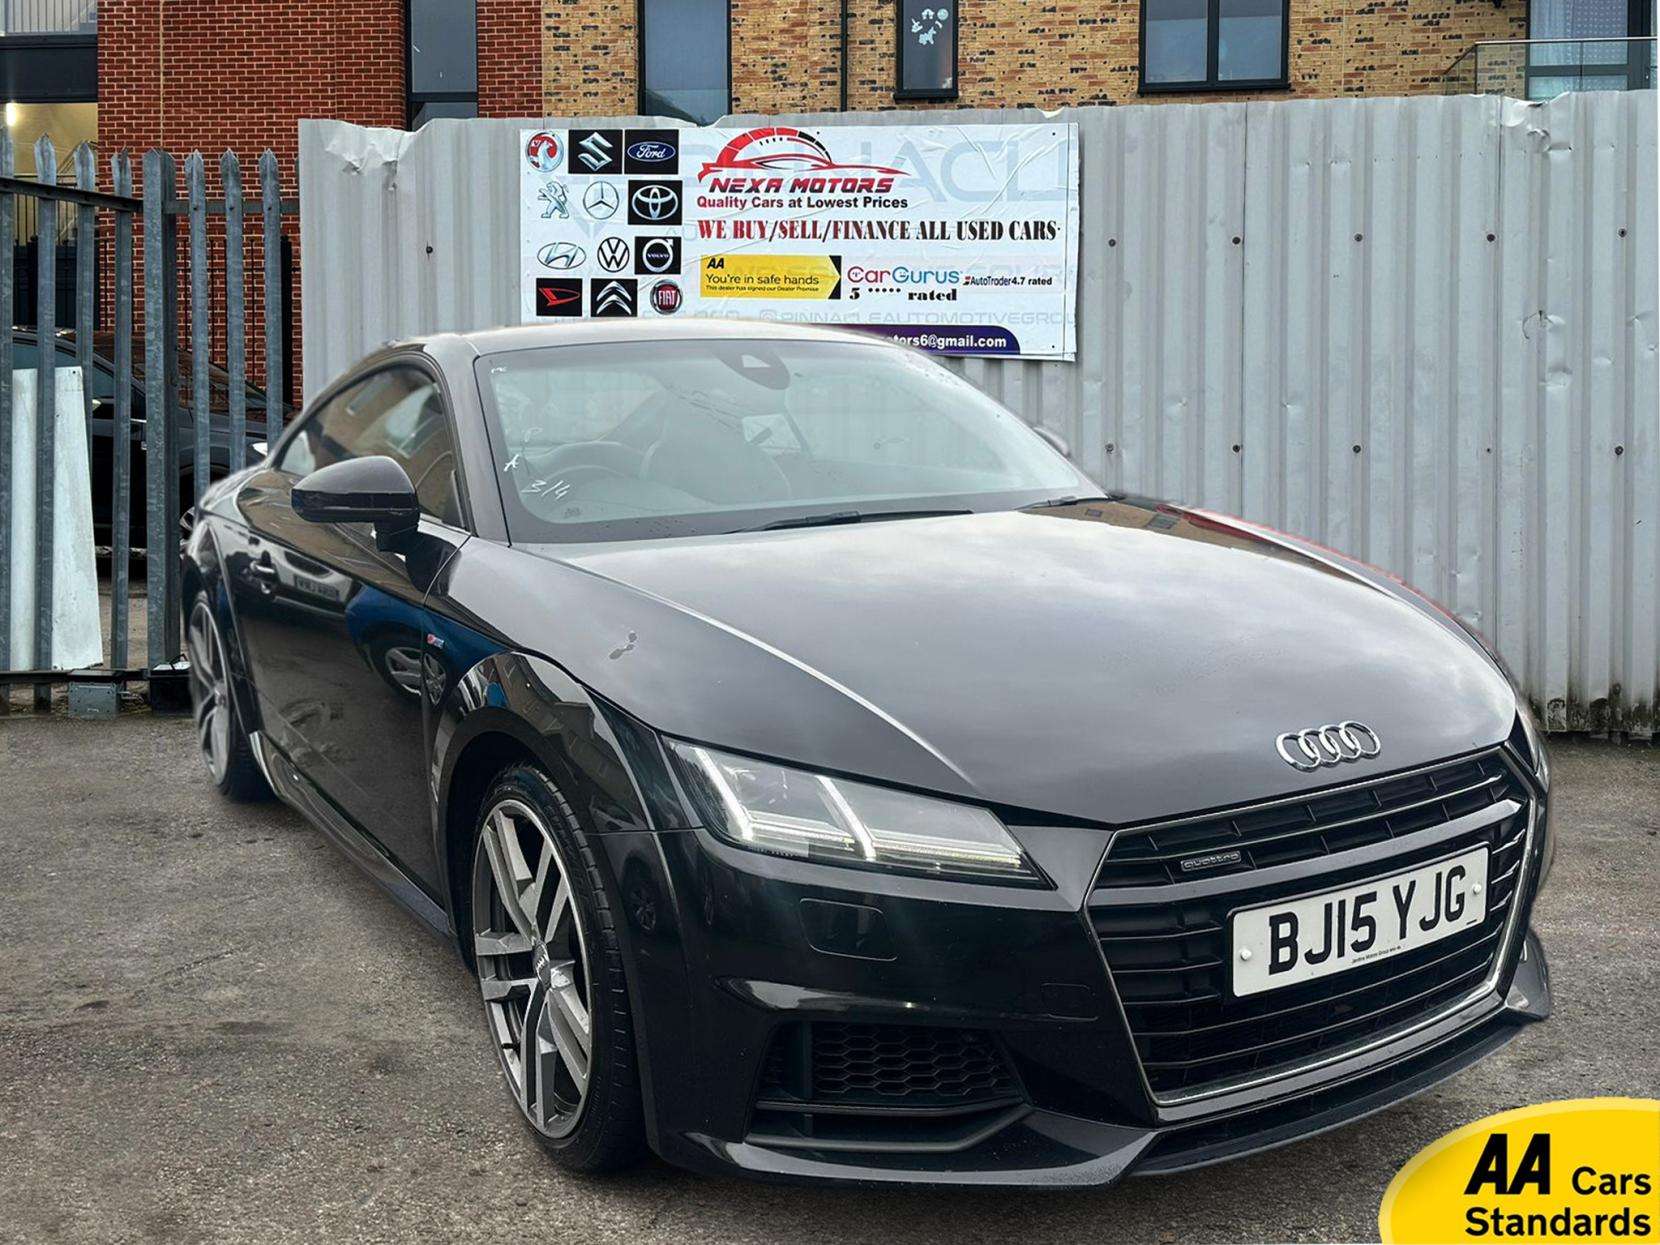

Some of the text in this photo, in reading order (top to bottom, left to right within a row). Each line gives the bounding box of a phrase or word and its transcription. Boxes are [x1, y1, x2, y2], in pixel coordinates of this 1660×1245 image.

[636, 144, 667, 158] Ford
[709, 178, 894, 194] NEXA MOTORS
[697, 195, 908, 211] Quality Cars at Lowest Prices
[697, 220, 727, 240] WE
[733, 219, 911, 242] BUY/SELL/FINANCE
[916, 220, 951, 240] ALL
[957, 220, 1004, 241] USED
[1008, 220, 1057, 241] CARS
[706, 257, 725, 270] AA
[706, 273, 820, 285] You're in safe hands
[847, 266, 960, 284] CarGurus
[1028, 276, 1053, 286] rated
[658, 290, 677, 306] FIAT
[849, 287, 958, 301] 5 rated
[1268, 864, 1466, 976] BJ15 YJG
